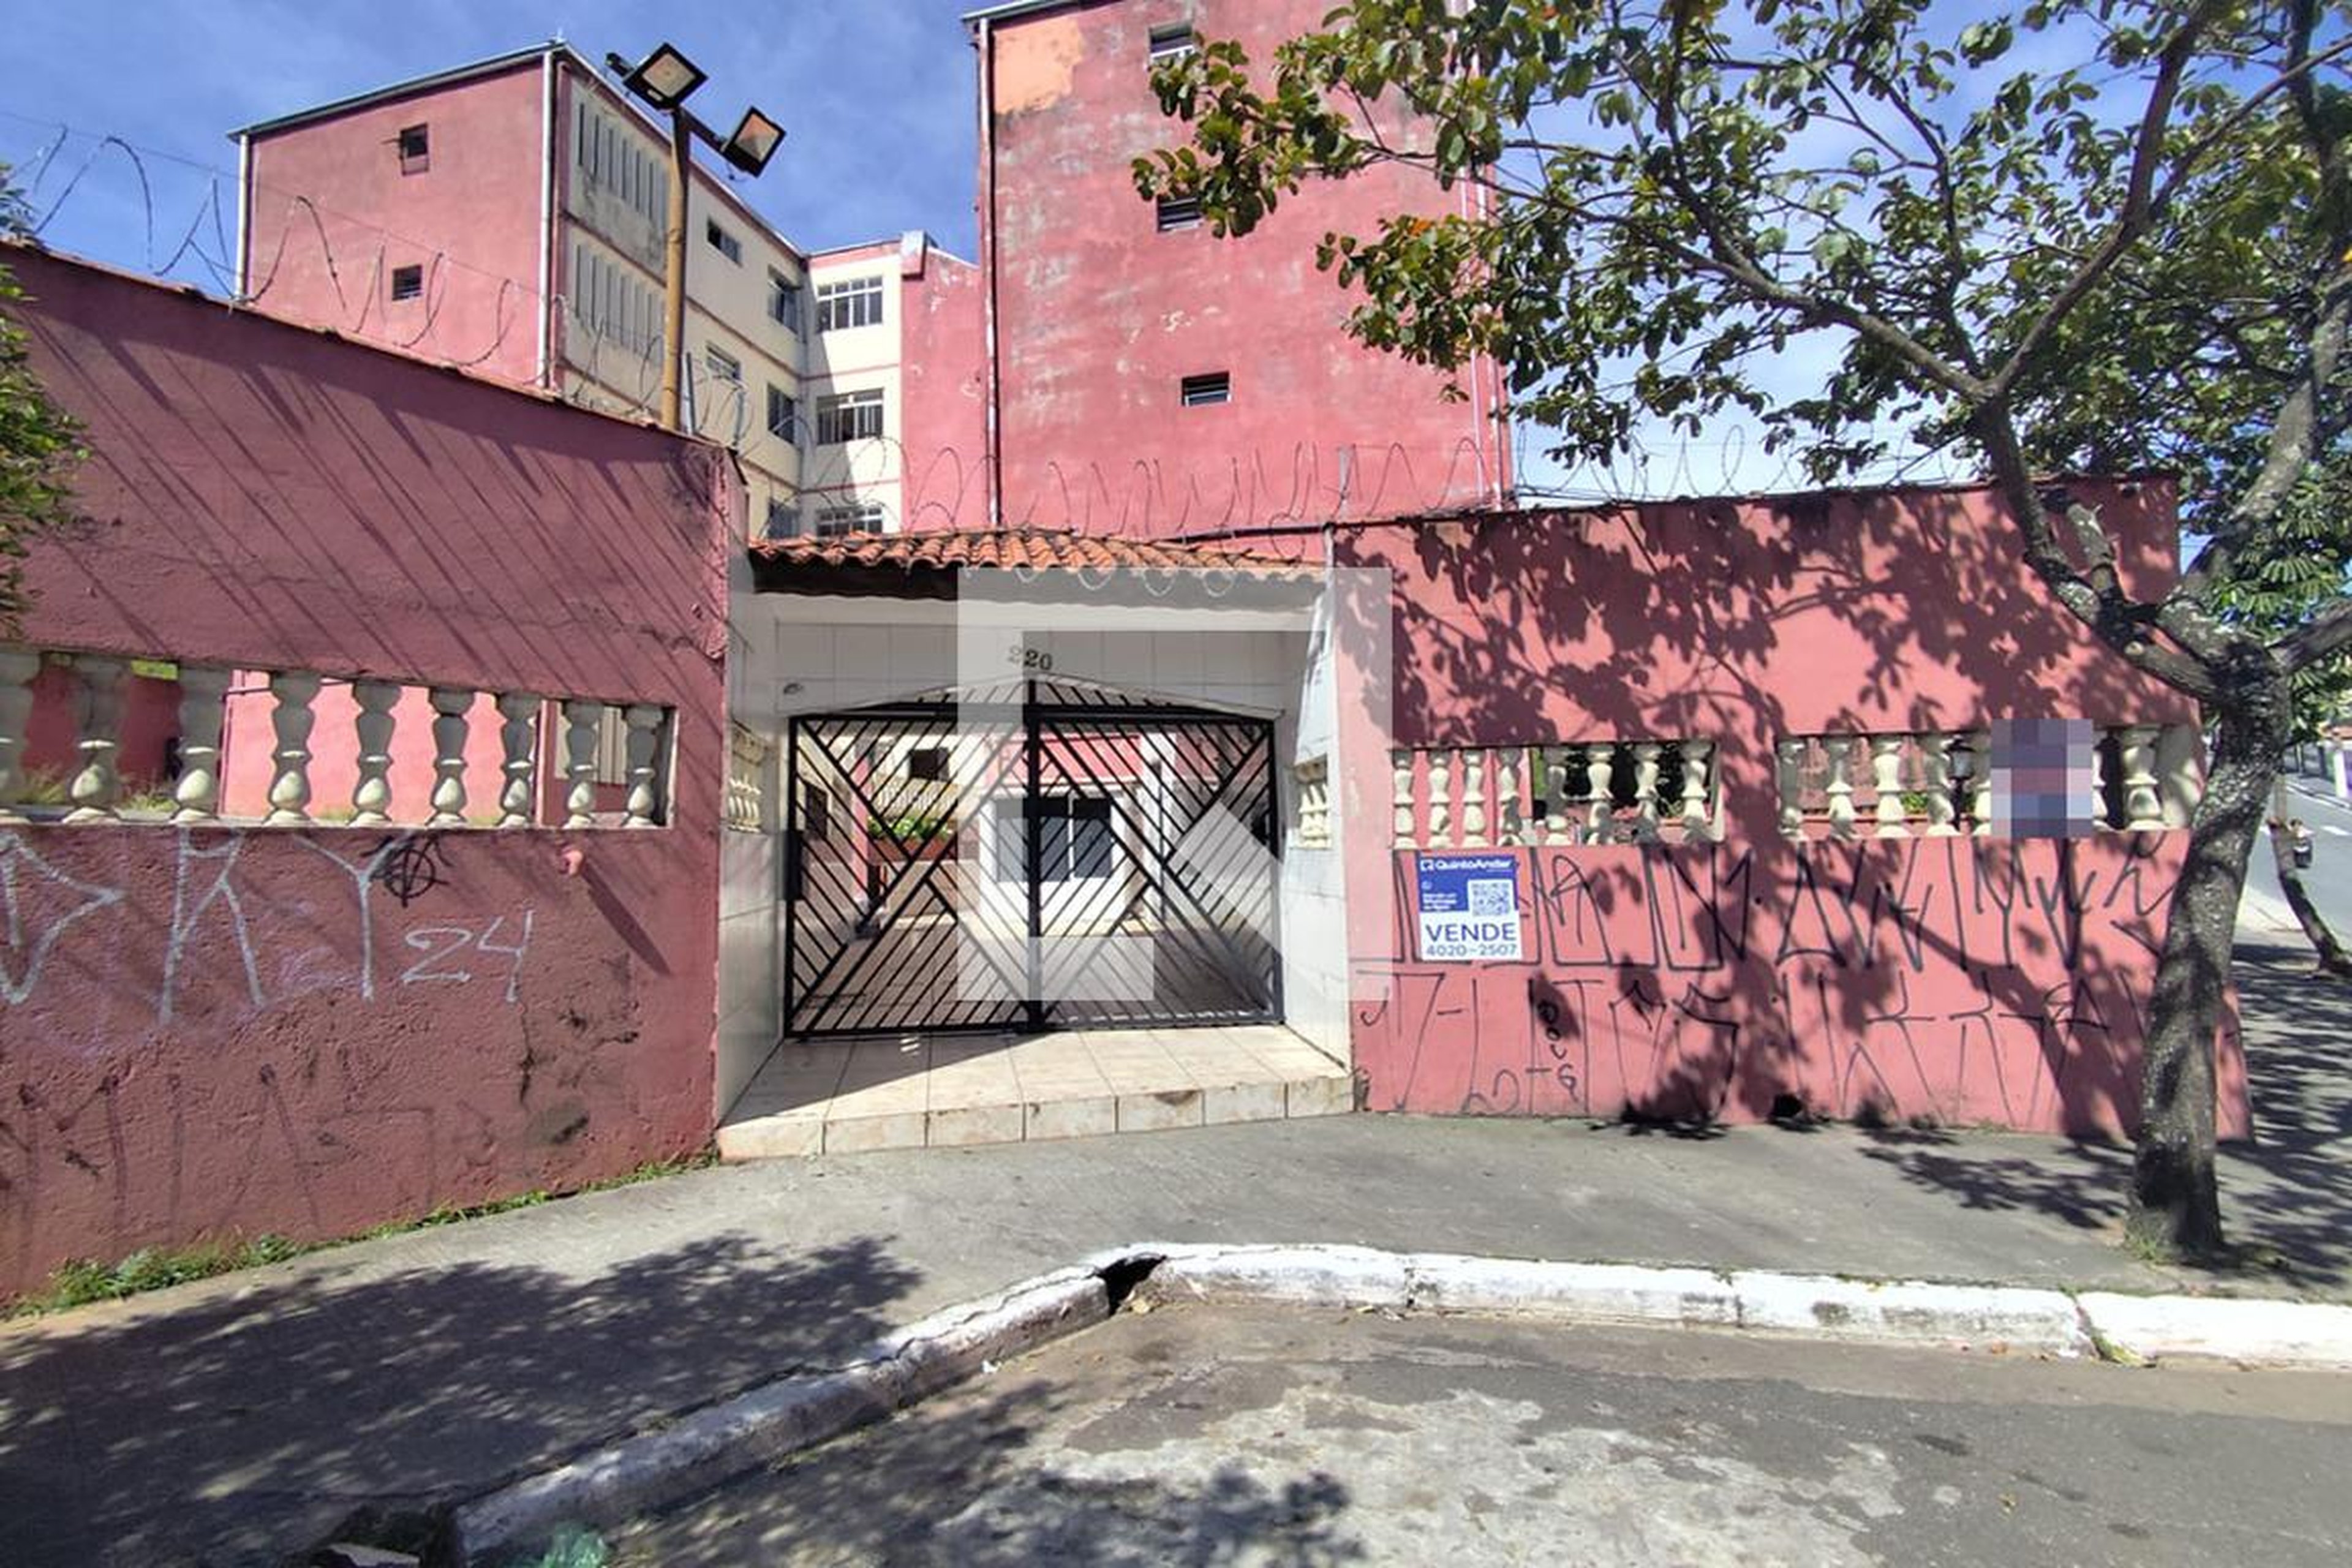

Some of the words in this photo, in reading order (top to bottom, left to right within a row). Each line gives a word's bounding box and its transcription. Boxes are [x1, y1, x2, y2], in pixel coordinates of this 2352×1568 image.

[1425, 923, 1517, 941] VENDE
[402, 907, 534, 1003] 24
[1425, 943, 1517, 957] 4020-2507
